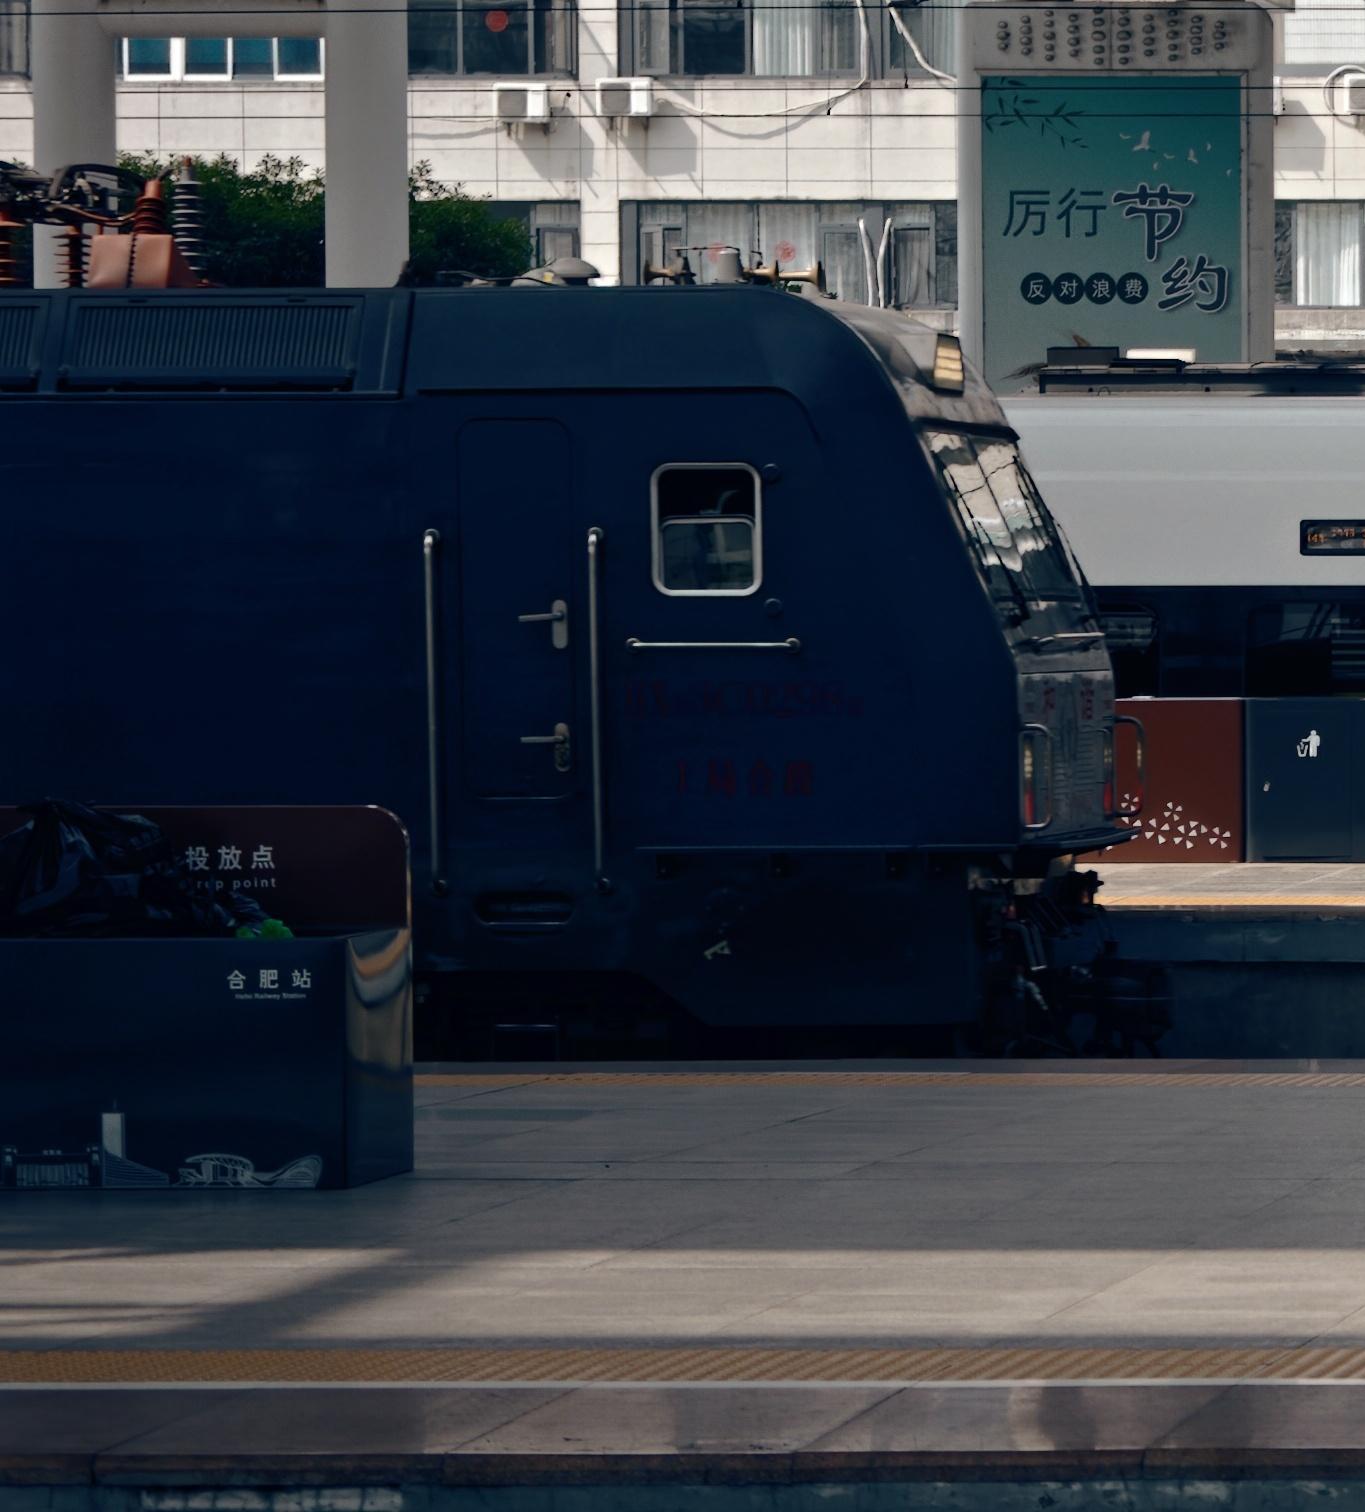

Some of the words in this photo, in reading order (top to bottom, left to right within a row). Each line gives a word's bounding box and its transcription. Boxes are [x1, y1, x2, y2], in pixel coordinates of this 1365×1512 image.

[1025, 277, 1147, 300] 反对浪费
[185, 844, 276, 870] 投放点
[232, 878, 276, 890] point
[226, 968, 312, 990] 合肥站
